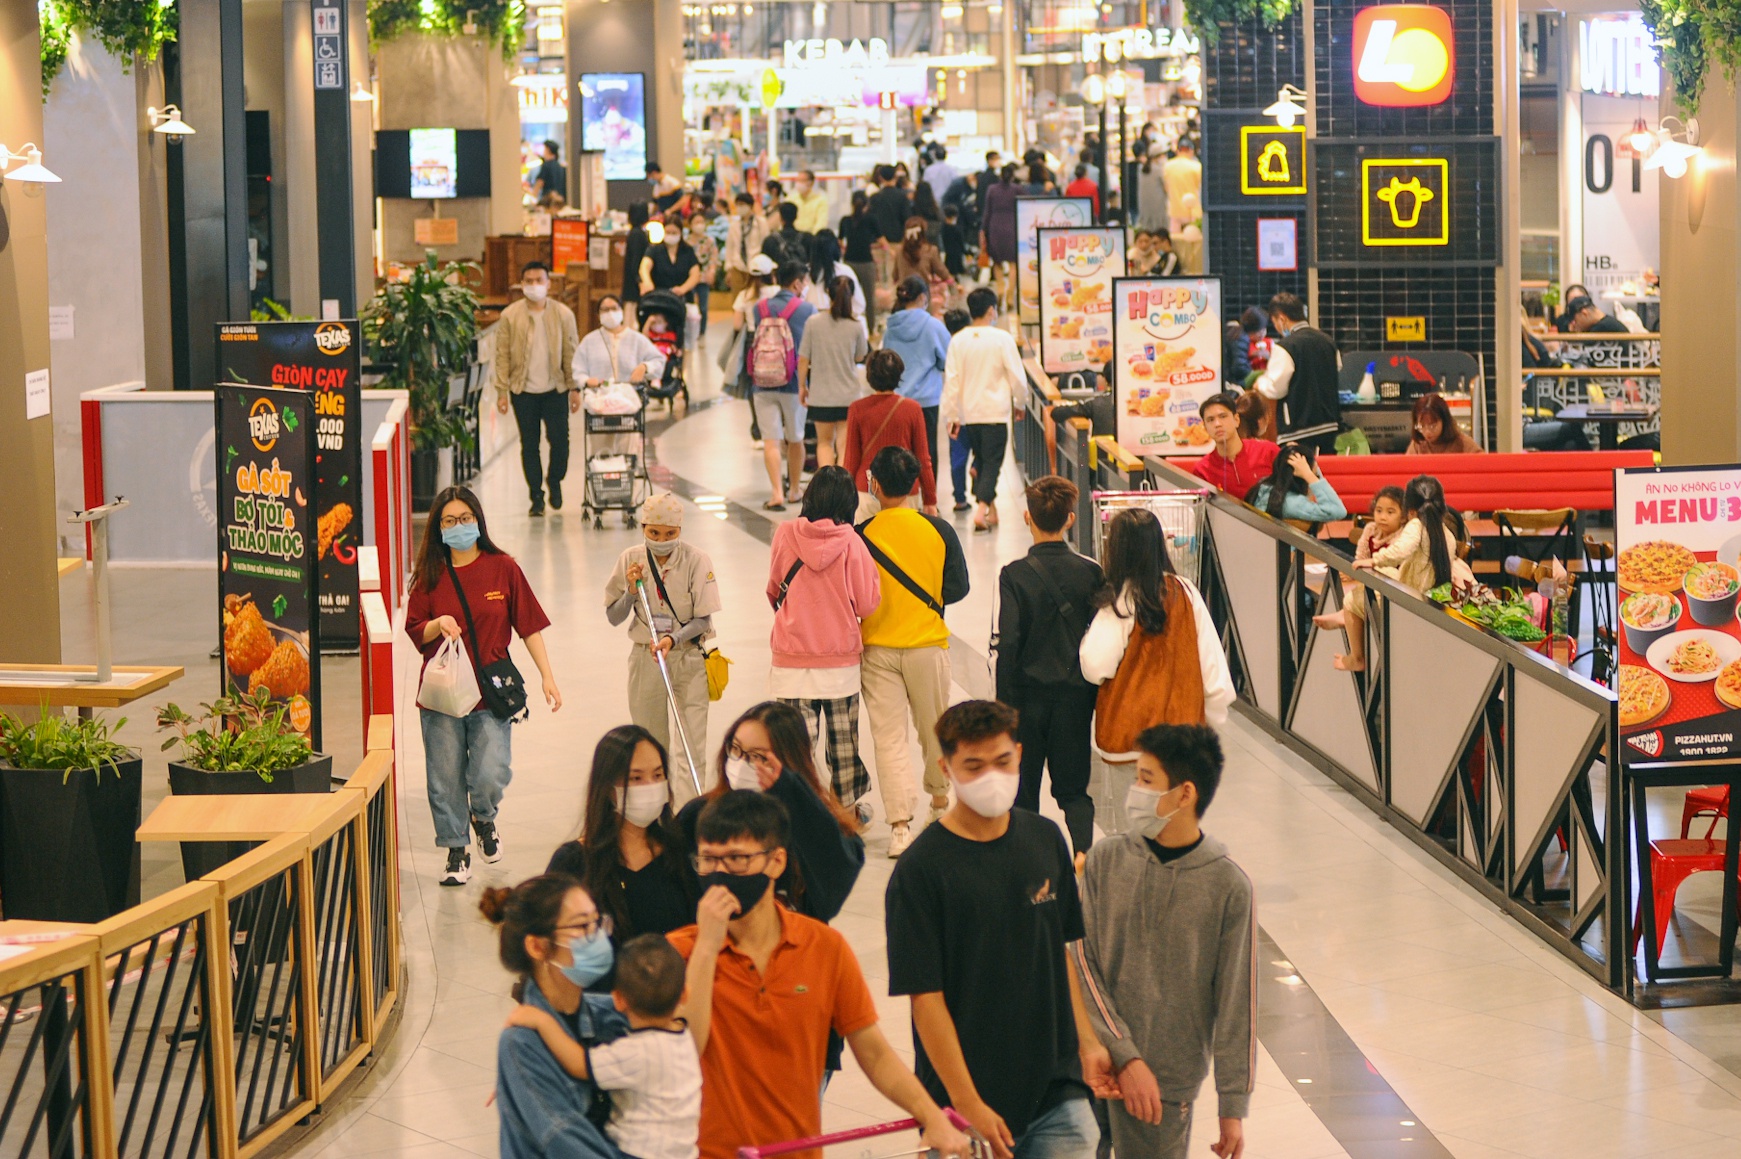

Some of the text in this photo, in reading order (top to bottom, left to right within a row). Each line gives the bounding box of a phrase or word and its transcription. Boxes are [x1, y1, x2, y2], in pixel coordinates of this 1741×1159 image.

[784, 38, 890, 69] KEBAB
[1050, 233, 1114, 261] Happy
[1128, 287, 1208, 320] Happy
[1150, 312, 1197, 328] COMBO
[313, 328, 351, 349] TEXAS
[271, 363, 348, 392] GIÒN CAY
[248, 412, 280, 440] TEXAS
[317, 434, 344, 450] VND
[236, 456, 292, 498] GÀ SỐT
[1681, 482, 1717, 493] KHÔNG
[256, 496, 284, 531] TỎI
[283, 508, 295, 529] &
[1635, 497, 1718, 525] MENU
[227, 524, 304, 562] THẢO MỘC
[1674, 733, 1734, 745] PIZZAHUT.VN
